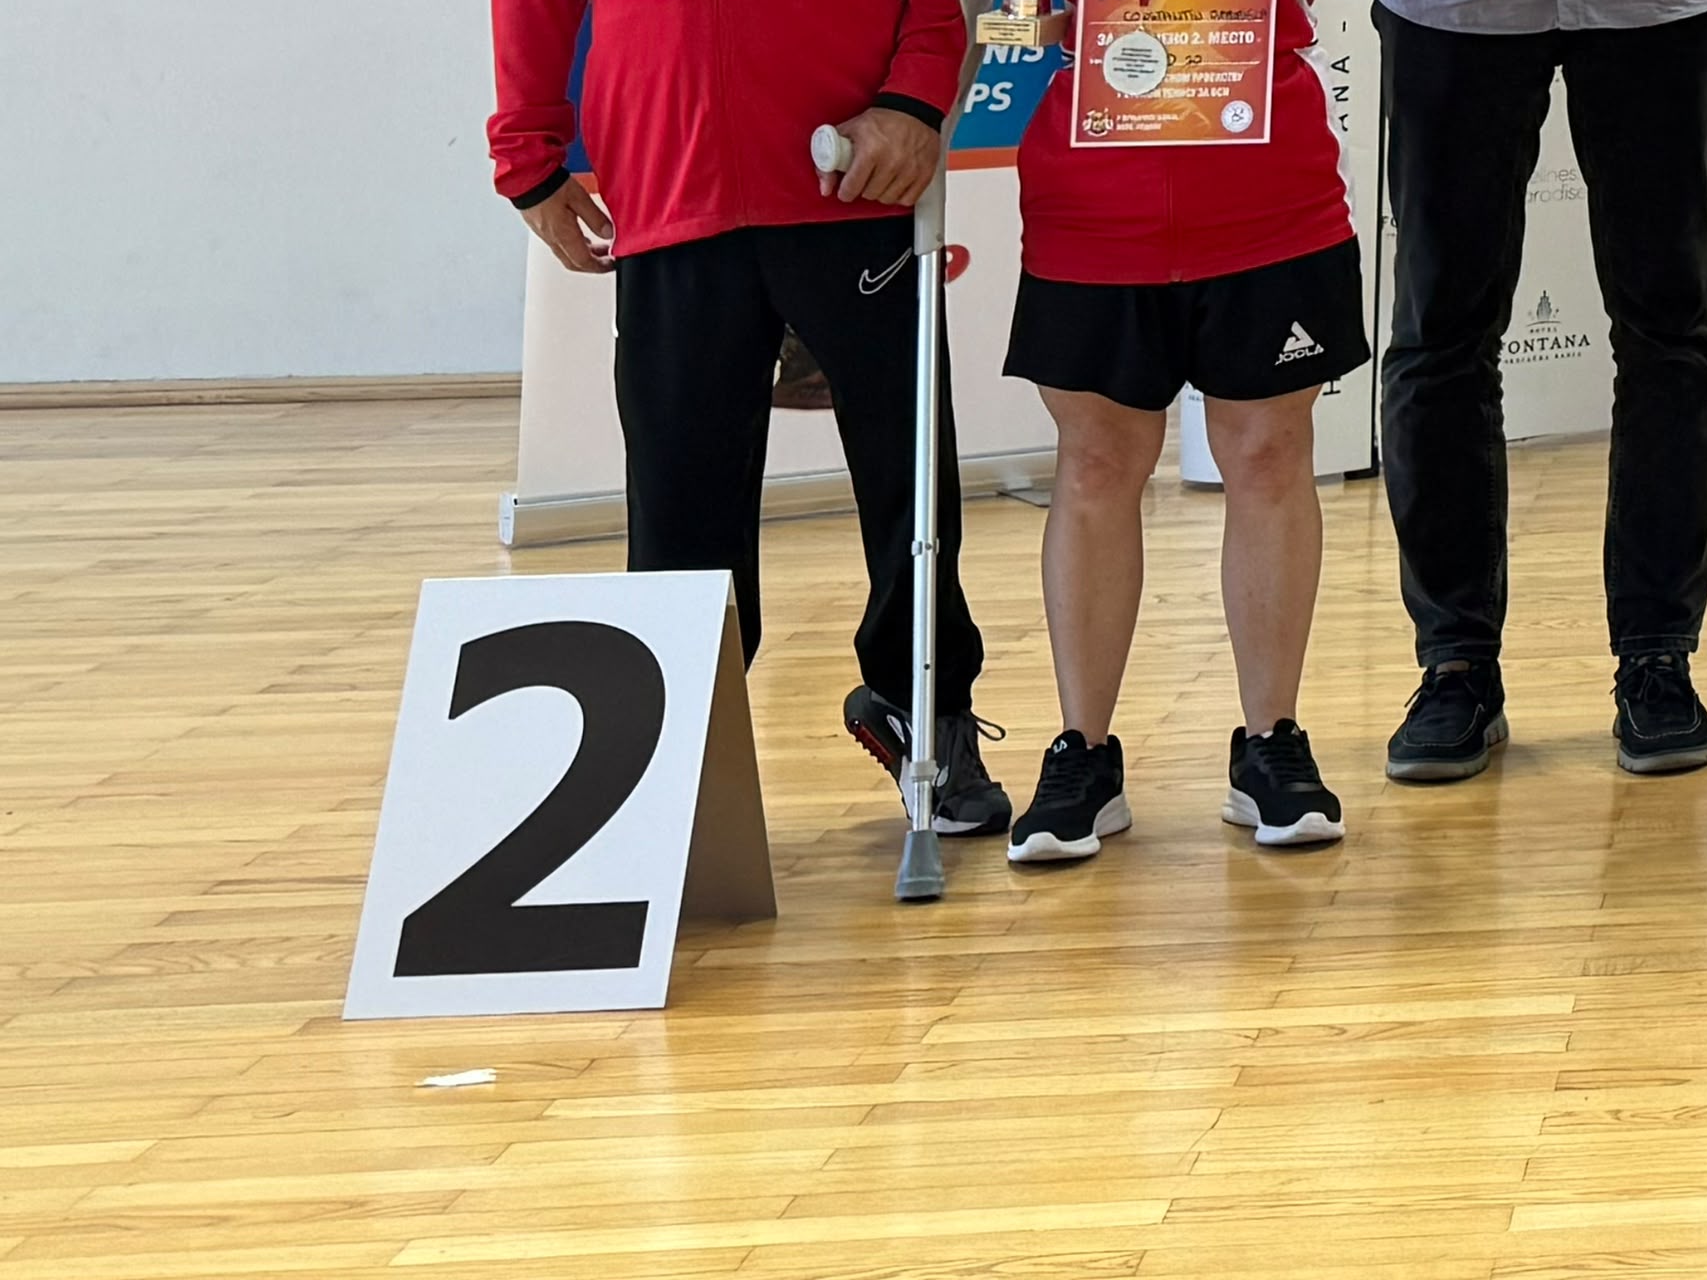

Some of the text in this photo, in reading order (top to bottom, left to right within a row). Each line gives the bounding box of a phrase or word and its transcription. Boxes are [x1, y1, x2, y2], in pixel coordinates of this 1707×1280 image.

[1208, 31, 1255, 45] МЕСТО
[1275, 343, 1325, 366] JOOLA
[392, 620, 667, 978] 2
